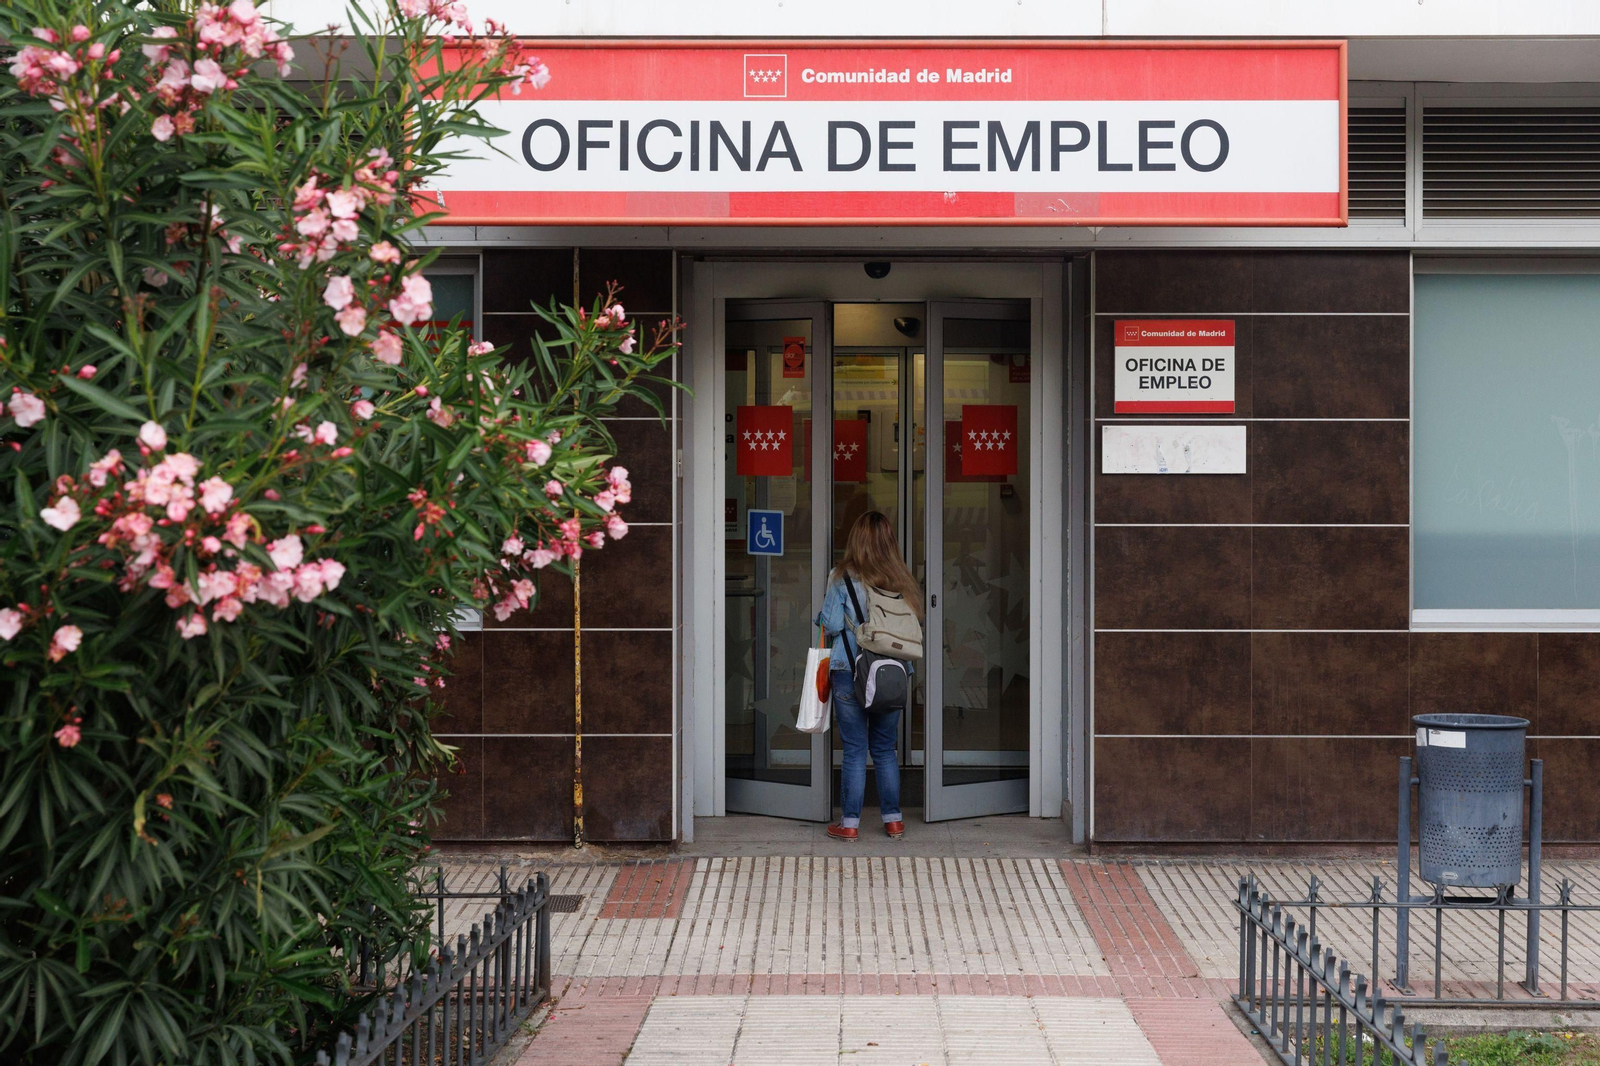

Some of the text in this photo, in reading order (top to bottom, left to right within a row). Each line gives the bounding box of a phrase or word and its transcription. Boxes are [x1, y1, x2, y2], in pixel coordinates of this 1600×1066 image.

[801, 67, 1013, 84] Comunidad de Madrid
[521, 118, 1230, 173] OFICINA DE EMPLEO
[1125, 358, 1226, 372] OFICINA DE
[1138, 375, 1212, 390] EMPLEO
